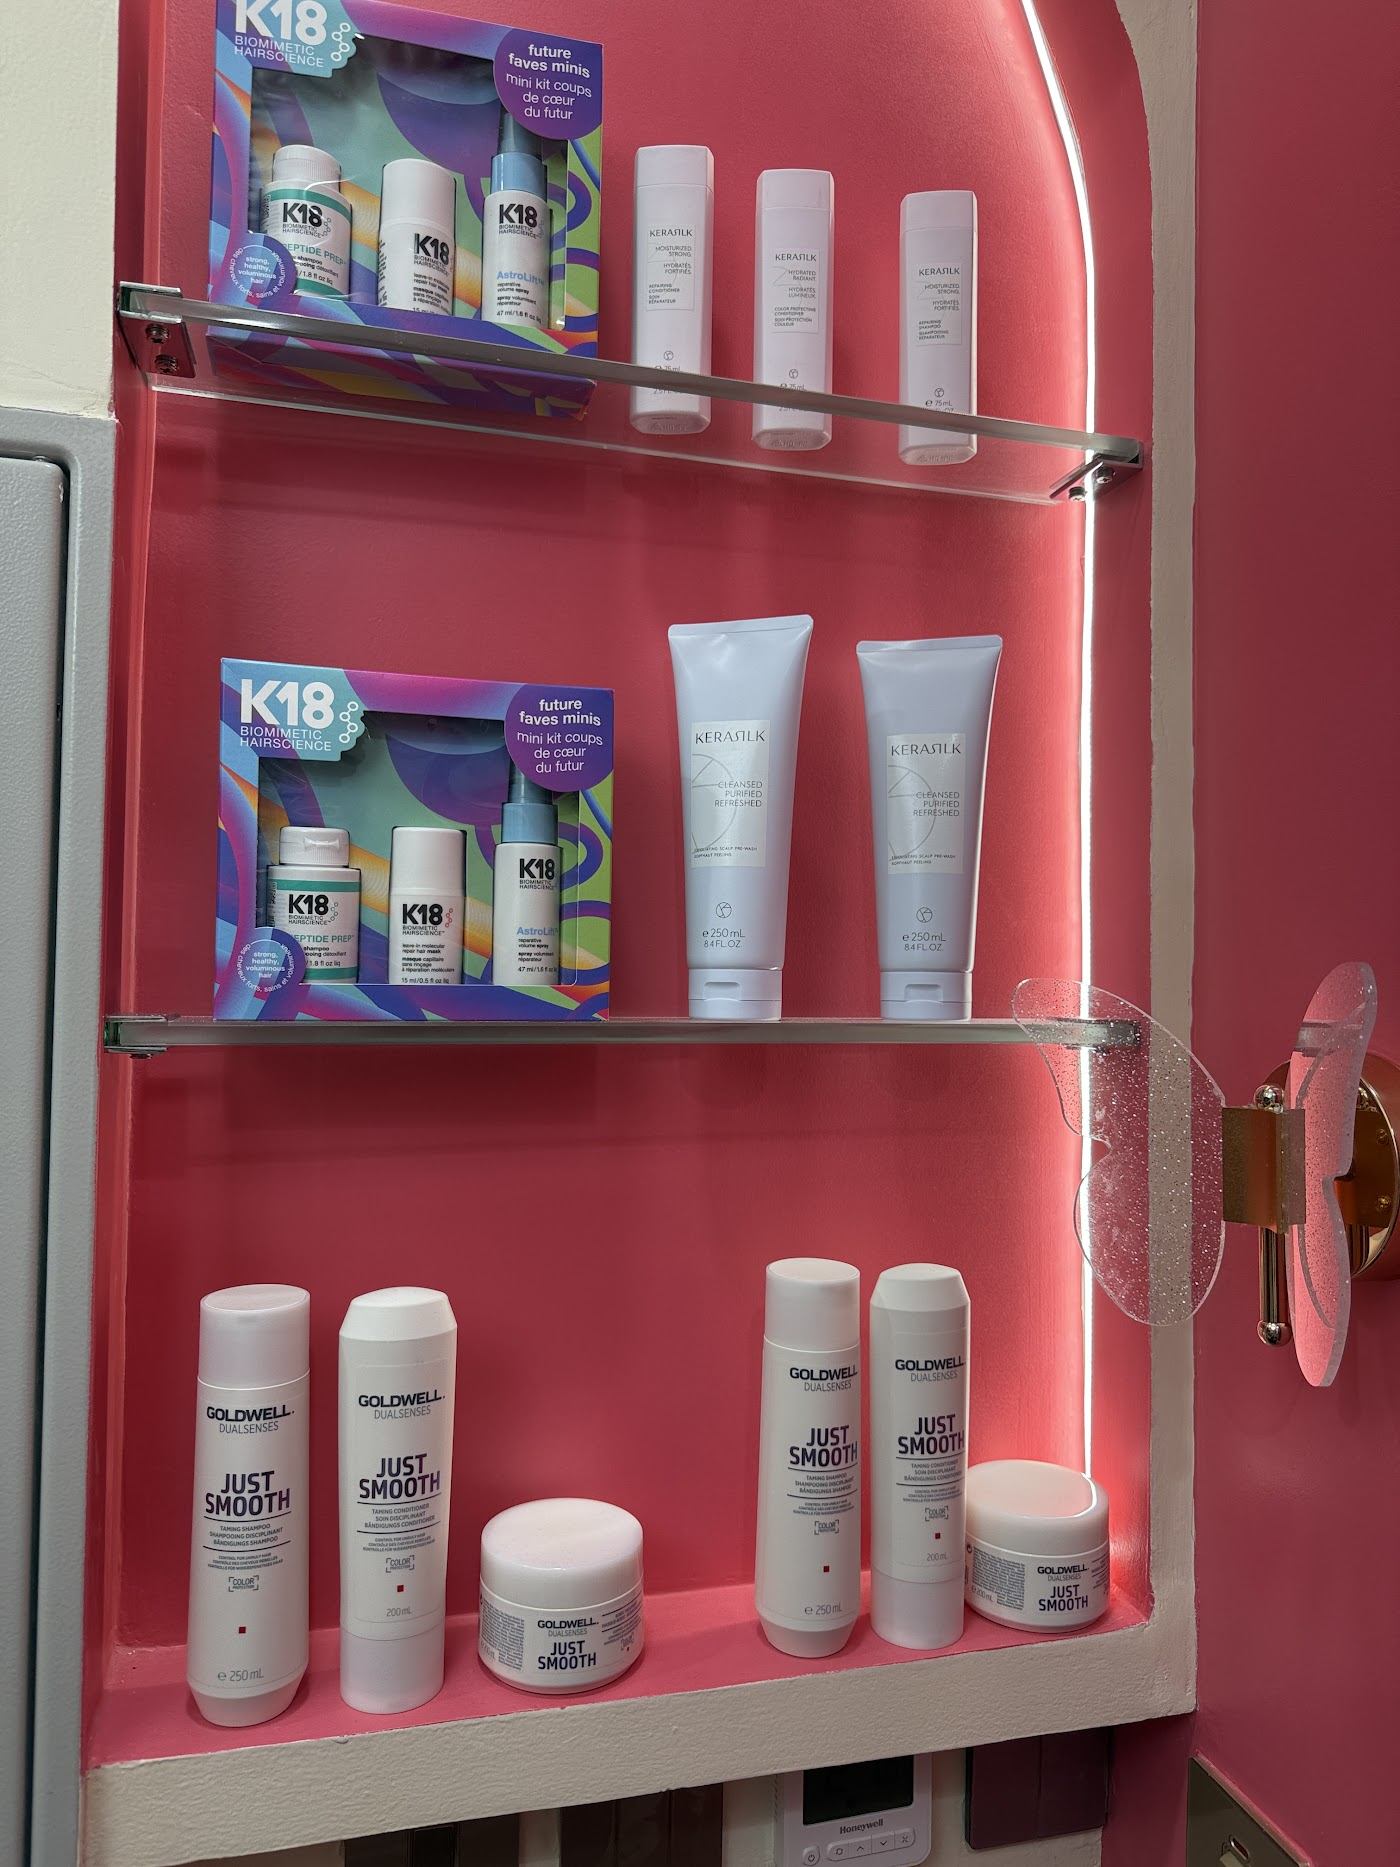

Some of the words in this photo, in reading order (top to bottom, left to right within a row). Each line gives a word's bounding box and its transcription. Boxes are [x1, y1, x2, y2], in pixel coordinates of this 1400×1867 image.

[236, 0, 327, 45] K18
[235, 36, 314, 55] BIOMIMETIC
[528, 44, 571, 59] future
[234, 46, 324, 67] HAIRSCIENCE
[508, 53, 548, 71] faves
[551, 61, 590, 78] minis
[506, 73, 532, 88] mini
[535, 78, 550, 90] kit
[553, 82, 592, 98] coups
[522, 91, 539, 104] de
[542, 95, 575, 106] cœur
[524, 106, 540, 118] du
[544, 107, 573, 119] futur
[282, 202, 323, 227] K18
[499, 203, 537, 228] K18
[649, 228, 693, 237] KERASILK
[414, 233, 450, 266] K18
[775, 253, 817, 262] KERASILK
[238, 269, 277, 280] voluminous
[918, 267, 960, 277] KERASILK
[240, 678, 335, 729] K18
[539, 699, 583, 711] future
[519, 710, 559, 725] faves
[562, 711, 601, 726] minis
[240, 726, 322, 740] BIOMIMETIC
[517, 731, 543, 744] mini
[547, 732, 561, 744] kit
[565, 733, 603, 746] coups
[695, 729, 765, 744] KERASILK
[240, 737, 332, 751] HAIRSCIENCE
[891, 743, 961, 756] KERASILK
[534, 747, 550, 759] de
[554, 747, 586, 758] cœur
[535, 761, 552, 773] du
[555, 760, 585, 772] futur
[717, 780, 763, 789] CLEANSED
[725, 790, 762, 798] PURIFIED
[915, 791, 960, 799] CLEANSED
[714, 799, 762, 808] REFRESHED
[923, 800, 960, 808] PURIFIED
[913, 809, 960, 817] REFRESHED
[519, 858, 556, 880] K18
[288, 893, 329, 916] K18
[402, 903, 443, 926] K18
[789, 1364, 858, 1381] GOLDWELL
[910, 1369, 958, 1382] DUALSENSES
[804, 1379, 852, 1392] DUALSENSES
[374, 1405, 431, 1420] DUALSENSES
[219, 1420, 279, 1434] DUALSENSES
[914, 1413, 956, 1435] JUST
[806, 1424, 849, 1447] JUST
[897, 1429, 965, 1455] SMOOTH
[789, 1440, 858, 1467] SMOOTH
[376, 1453, 428, 1478] JUST
[220, 1470, 275, 1494] JUST
[359, 1470, 440, 1499] SMOOTH
[205, 1488, 290, 1517] SMOOTH
[393, 1503, 430, 1514] CONDITIONER
[389, 1511, 426, 1521] DISCIPLINANT
[209, 1531, 245, 1540] SHAMPOOING
[245, 1527, 284, 1539] DISCIPLINANT
[241, 1523, 272, 1532] SHAMPOO
[249, 1536, 279, 1546] SHAMPOO
[389, 1558, 411, 1567] COLOR
[232, 1578, 255, 1586] COLOR
[1050, 1584, 1080, 1598] JUST
[1038, 1595, 1089, 1612] SMOOTH
[547, 1628, 588, 1637] DUALSENSES
[550, 1640, 586, 1655] JUST
[538, 1652, 597, 1670] SMOOTH
[229, 1669, 249, 1682] 250
[839, 1818, 884, 1835] Honeywell
